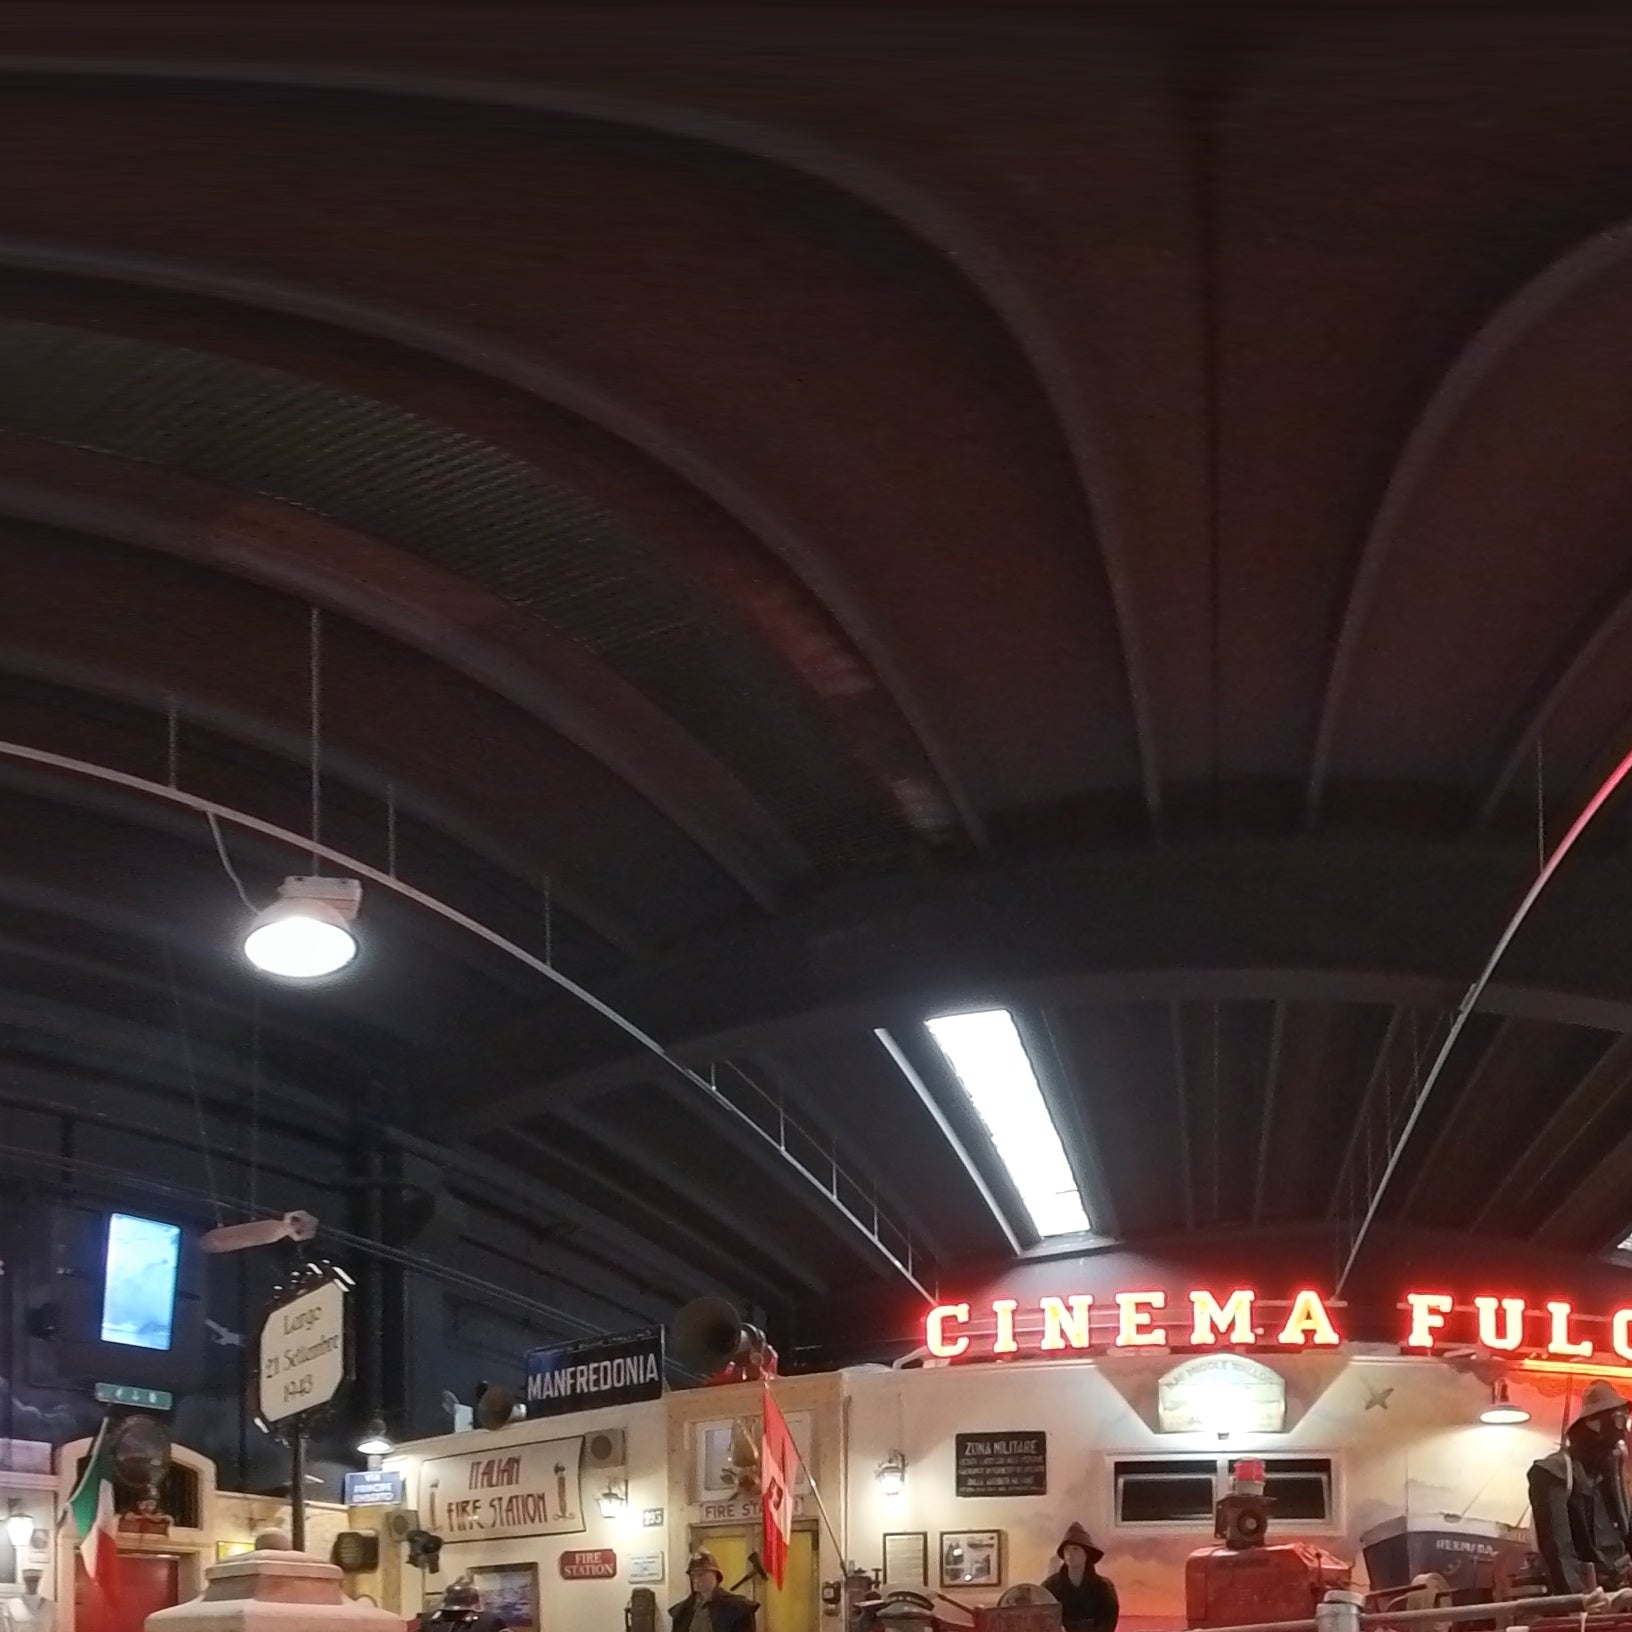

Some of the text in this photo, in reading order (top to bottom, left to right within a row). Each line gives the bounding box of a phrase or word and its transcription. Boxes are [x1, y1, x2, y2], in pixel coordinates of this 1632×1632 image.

[925, 1289, 1340, 1358] CINEMA
[527, 1352, 659, 1401] MANFREDONIA
[965, 1440, 1038, 1456] ZONA MILITARE
[469, 1456, 522, 1490] ITALIAN
[447, 1492, 548, 1532] FIRE STATION
[705, 1504, 736, 1518] FIRE
[564, 1563, 614, 1577] STATION
[574, 1552, 603, 1564] FIRE
